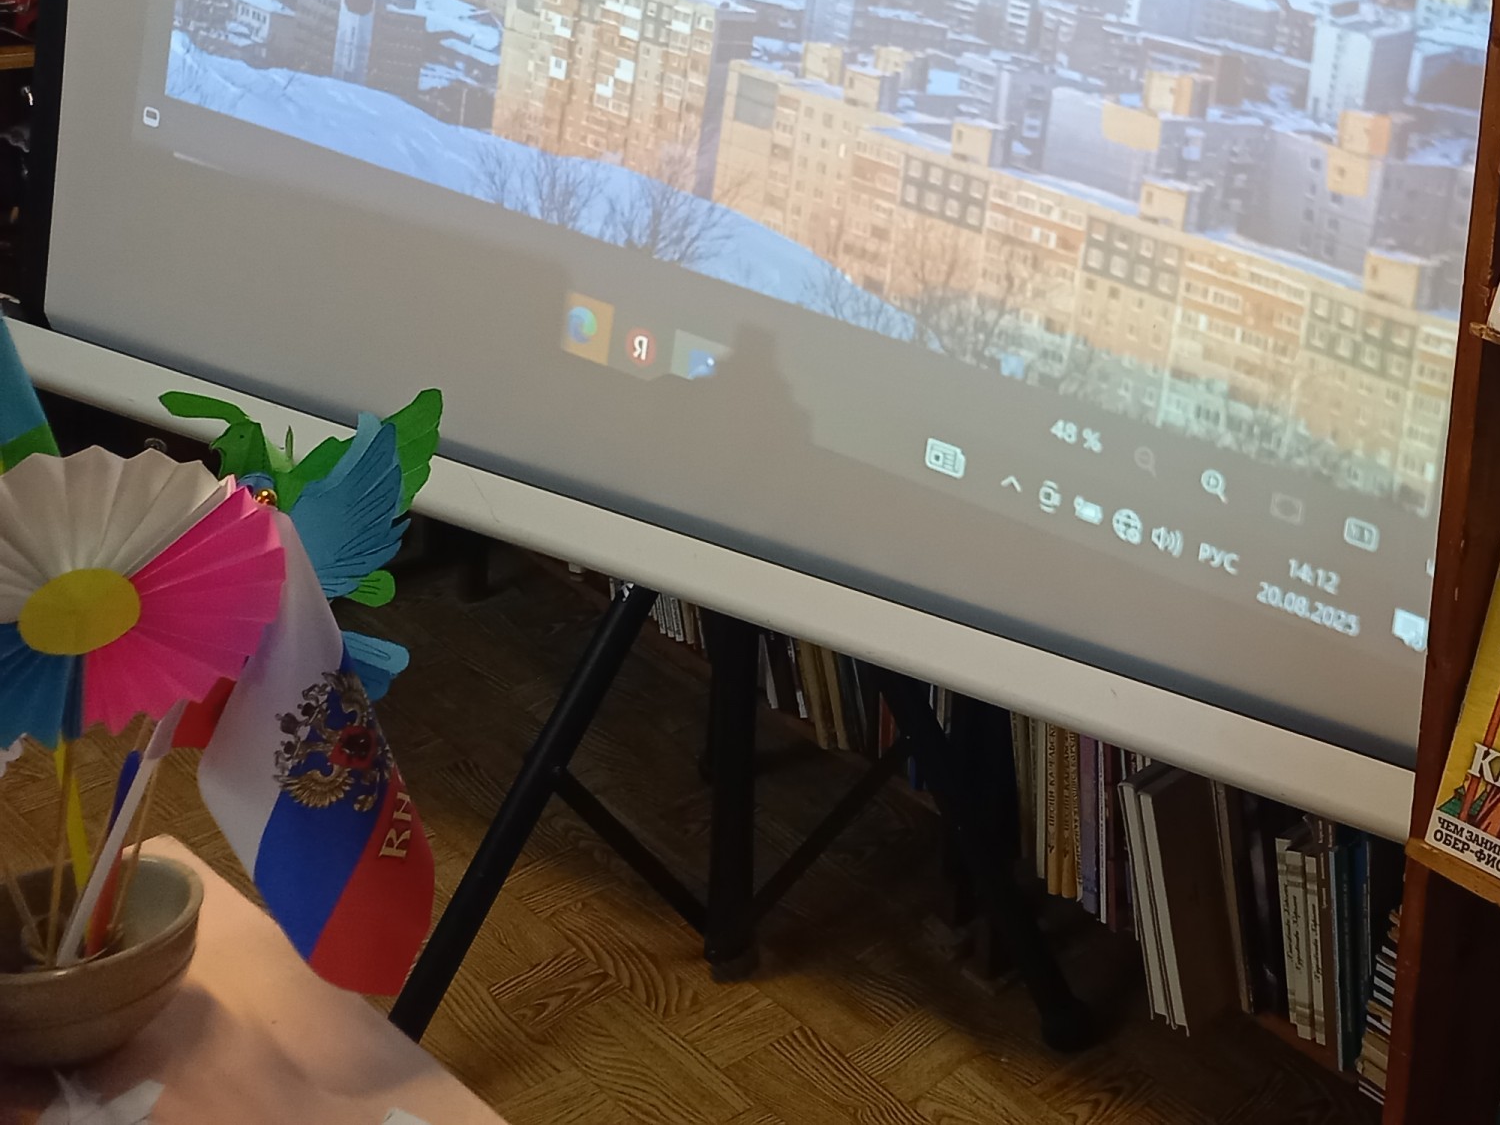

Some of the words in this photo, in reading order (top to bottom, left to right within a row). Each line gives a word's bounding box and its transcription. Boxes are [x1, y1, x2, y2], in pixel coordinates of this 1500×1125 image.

[632, 334, 649, 362] Я
[1049, 418, 1079, 443] 48
[1082, 428, 1103, 453] %
[1198, 541, 1240, 575] РУС
[1288, 558, 1342, 595] 14:12
[1256, 581, 1362, 638] 20.08.2025
[1437, 816, 1465, 838] ЧЕМ
